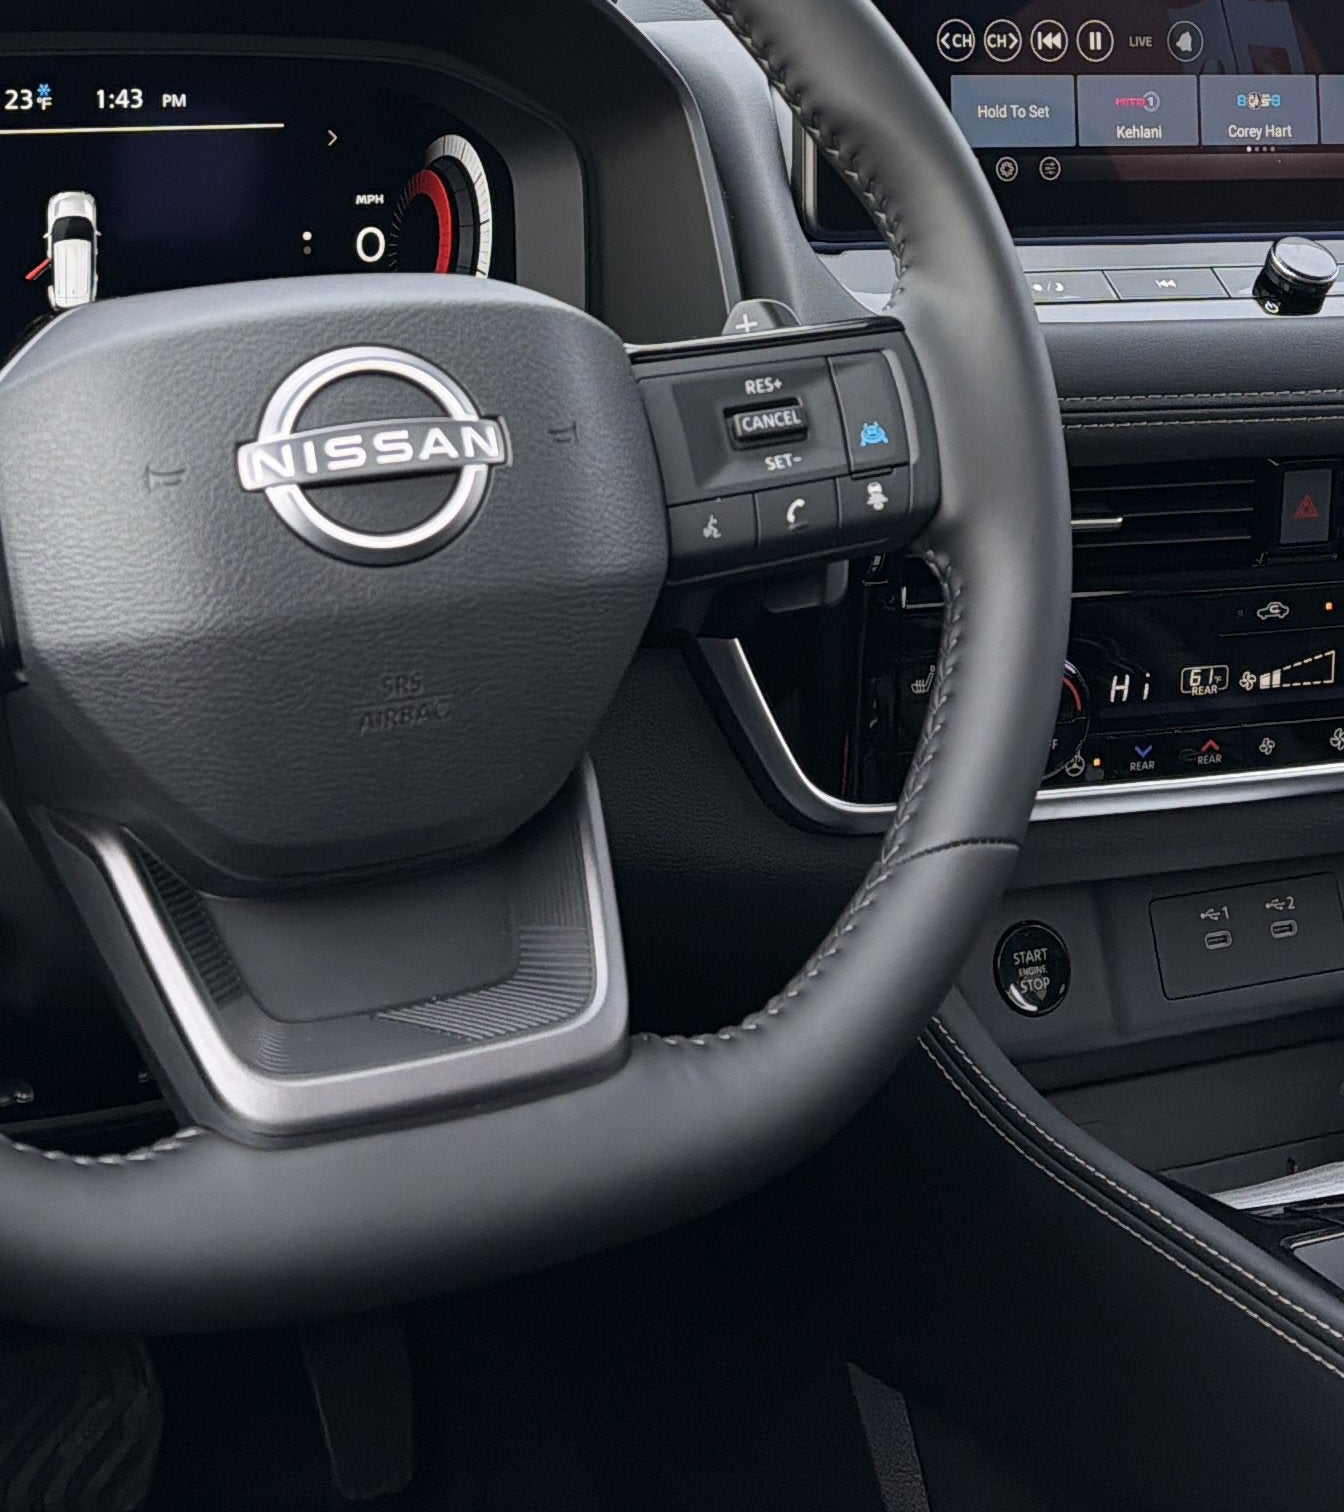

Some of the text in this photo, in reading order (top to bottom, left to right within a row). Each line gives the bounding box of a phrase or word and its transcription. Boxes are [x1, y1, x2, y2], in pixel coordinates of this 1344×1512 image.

[1129, 36, 1152, 48] LIVE
[96, 88, 186, 110] 1:43 PM
[977, 104, 1050, 119] Hold To Set
[1116, 125, 1163, 139] Kehlani
[1228, 124, 1292, 141] Corey Hart
[355, 194, 385, 206] MPH
[355, 225, 386, 263] 0
[744, 376, 783, 395] RES+
[741, 410, 802, 432] CANCEL
[251, 423, 500, 483] NISSAN
[1109, 671, 1151, 703] Hi
[1191, 684, 1218, 696] REAR
[1129, 760, 1155, 771] REAR
[1197, 754, 1223, 765] REAR
[1286, 896, 1296, 910] 2
[1221, 905, 1229, 919] 1
[1013, 948, 1048, 965] START
[1018, 965, 1047, 977] ENGINE
[1021, 977, 1051, 994] STOP
